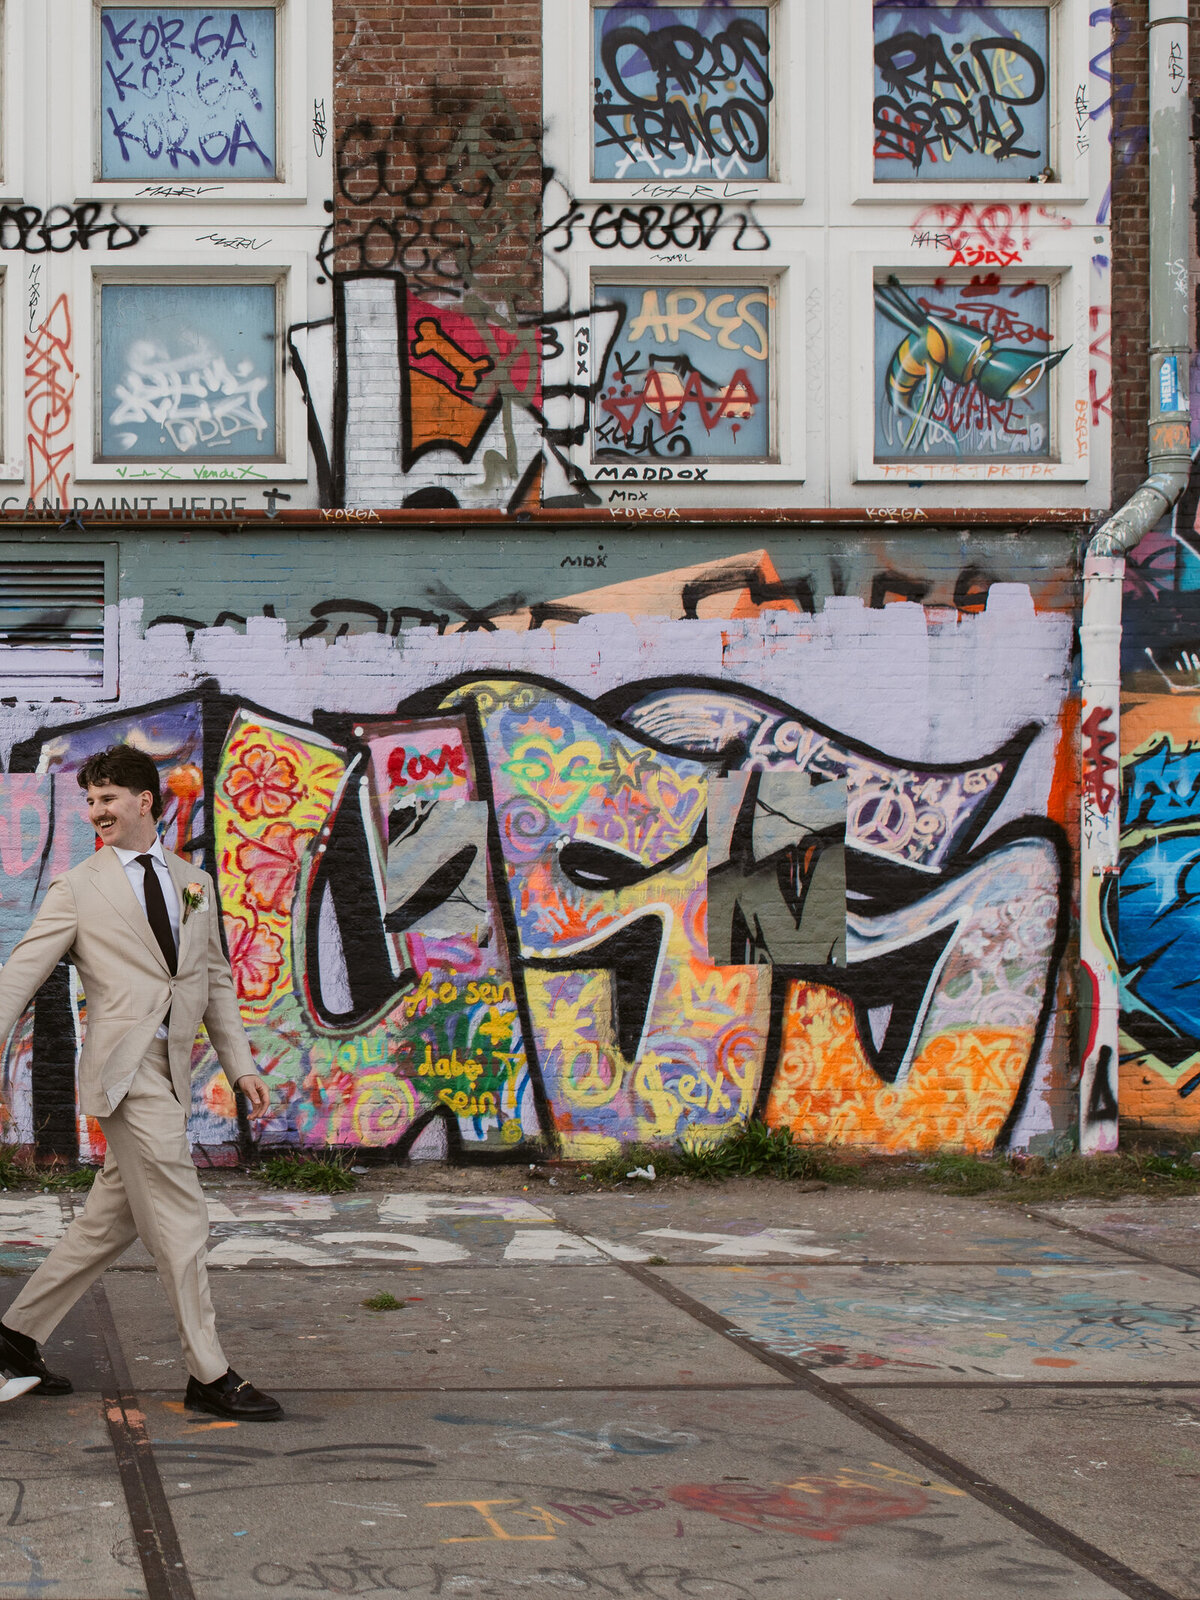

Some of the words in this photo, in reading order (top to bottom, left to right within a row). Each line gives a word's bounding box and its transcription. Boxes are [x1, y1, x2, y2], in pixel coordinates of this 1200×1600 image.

[628, 287, 778, 361] ARES
[1160, 362, 1173, 404] HELLO
[595, 467, 709, 481] MADDOX
[1, 496, 64, 521] CAN
[70, 496, 160, 521] PAINT
[169, 496, 247, 521] HERE
[322, 508, 380, 520] KORGA
[609, 507, 680, 519] KORGA
[866, 507, 928, 520] KORGA
[464, 968, 517, 1004] sein
[438, 1081, 499, 1117] sein
